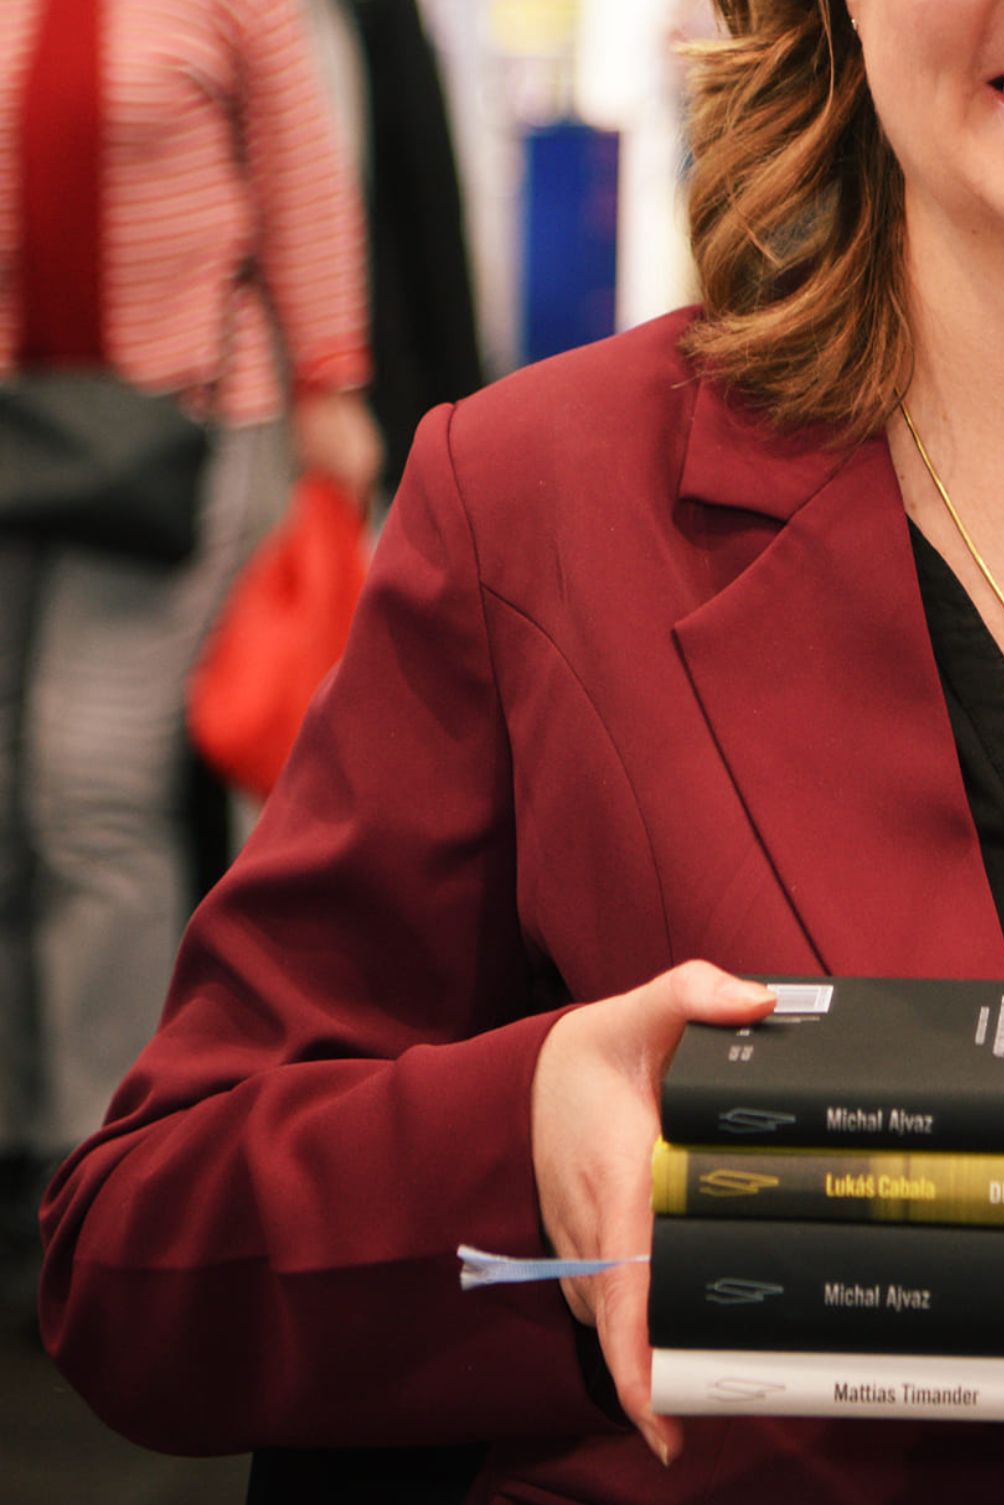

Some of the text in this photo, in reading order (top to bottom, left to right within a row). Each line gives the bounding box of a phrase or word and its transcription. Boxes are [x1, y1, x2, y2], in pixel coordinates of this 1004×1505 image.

[826, 1106, 933, 1136] Michal Ajvaz
[879, 1174, 936, 1199] Cabala
[824, 1282, 931, 1312] Michal Ajvaz
[834, 1381, 979, 1406] Mattias Timander
